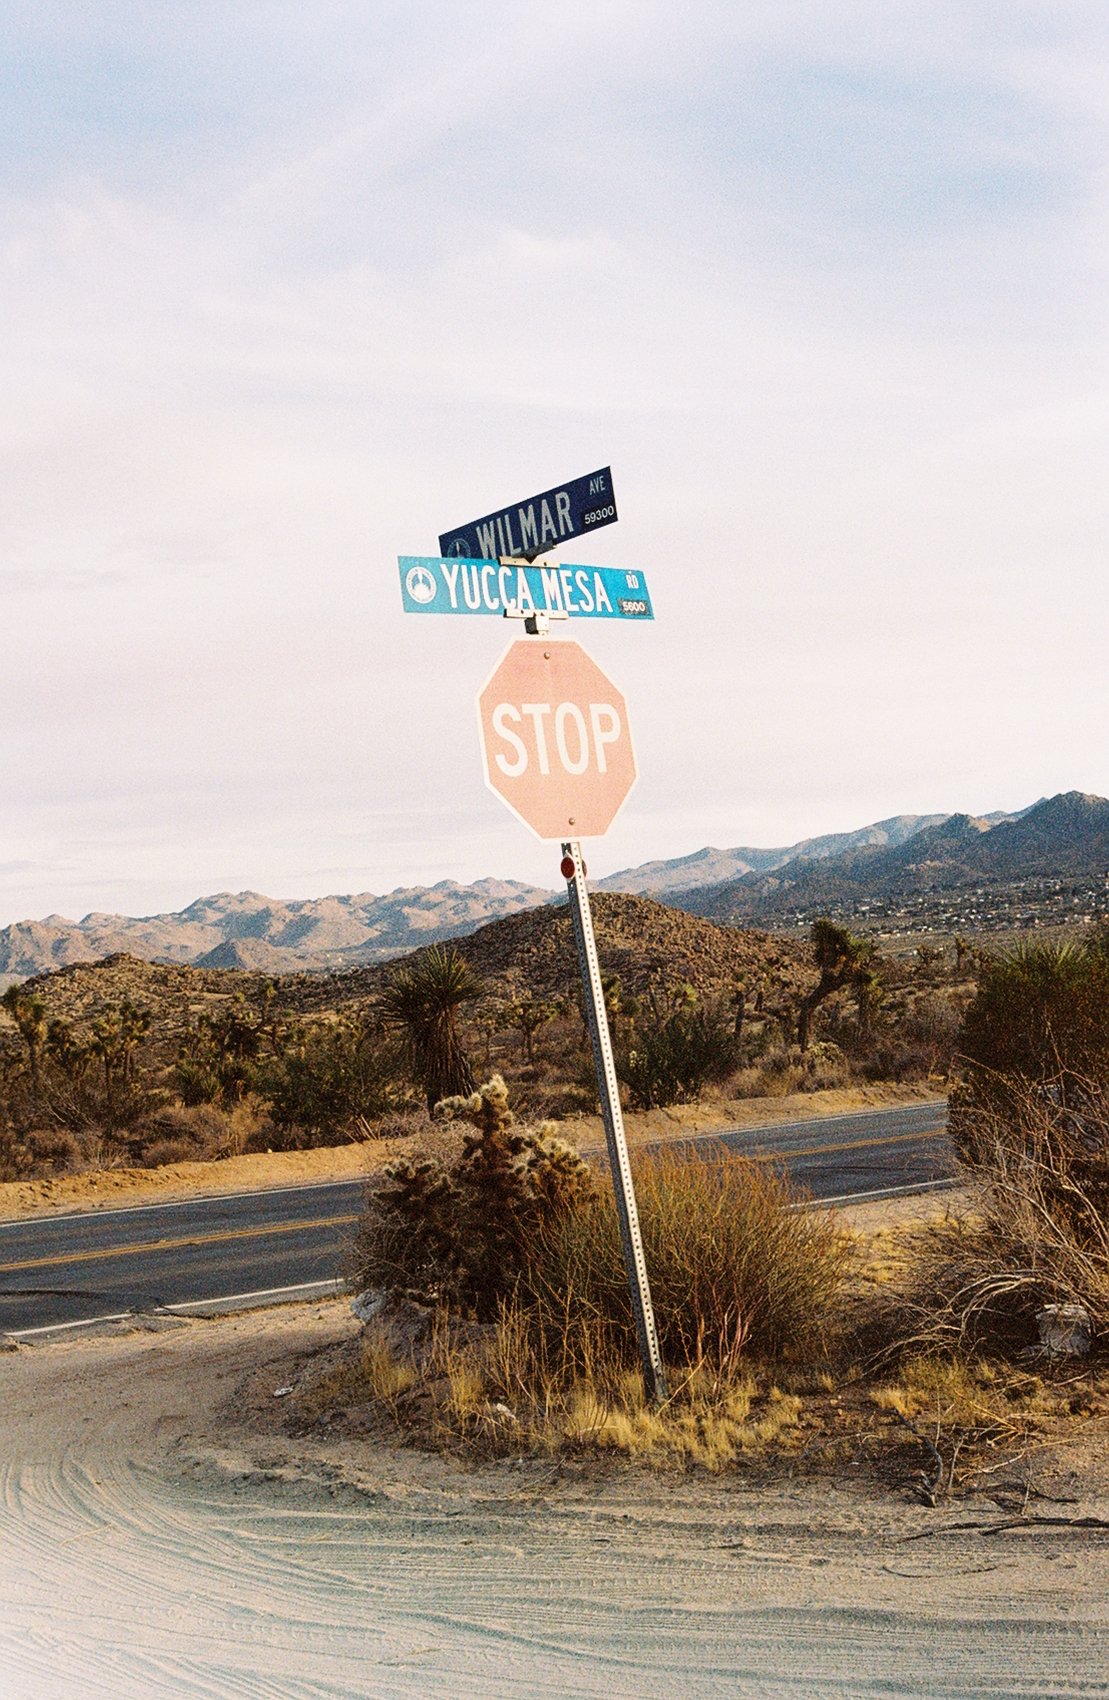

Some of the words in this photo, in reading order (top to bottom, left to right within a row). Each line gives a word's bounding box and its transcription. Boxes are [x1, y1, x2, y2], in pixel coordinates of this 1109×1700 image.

[476, 491, 574, 560] WILMAR
[589, 475, 606, 496] AVE
[584, 505, 615, 525] 59300
[440, 563, 534, 611] YUCCA
[541, 566, 613, 613] MESA
[625, 574, 639, 589] RD
[492, 702, 622, 778] STOP
